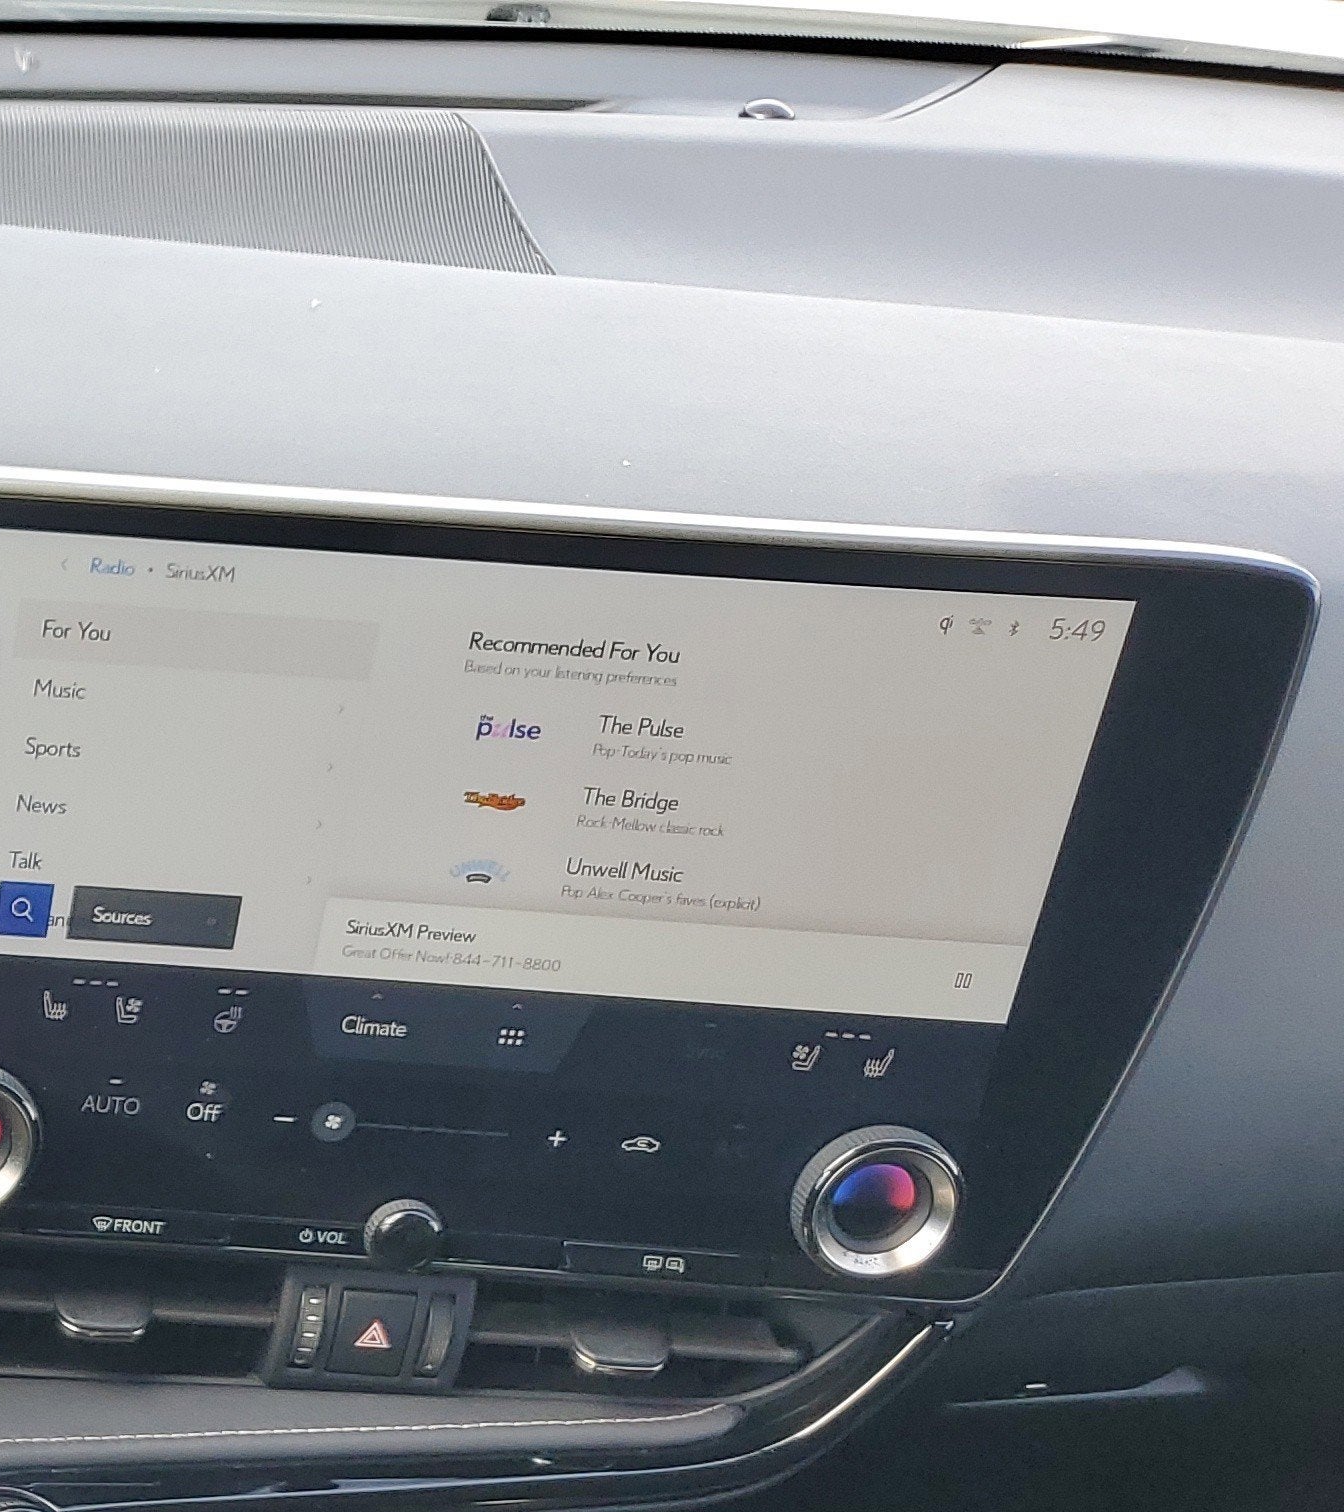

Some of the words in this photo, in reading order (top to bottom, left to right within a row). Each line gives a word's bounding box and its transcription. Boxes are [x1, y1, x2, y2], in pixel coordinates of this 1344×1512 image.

[90, 557, 135, 576] Radio
[166, 563, 235, 583] SiriusXM
[42, 619, 71, 638] For
[78, 622, 111, 641] You
[1049, 617, 1106, 642] 5:49
[469, 631, 606, 659] Recommended
[609, 641, 640, 661] For
[646, 643, 680, 663] You
[464, 660, 502, 675] Based
[505, 665, 520, 676] on
[524, 666, 550, 678] your
[555, 666, 602, 686] listening
[605, 671, 677, 687] preferences
[33, 679, 86, 699] Music
[600, 714, 633, 735] The
[637, 717, 684, 738] Pulse
[25, 737, 81, 760] Sports
[668, 751, 693, 765] pop
[696, 751, 732, 765] music
[16, 794, 67, 815] News
[584, 787, 616, 806] The
[621, 789, 679, 814] Bridge
[660, 819, 695, 835] classic
[698, 823, 724, 837] rock
[10, 850, 42, 870] Talk
[566, 857, 628, 879] Unwell
[631, 861, 685, 883] Music
[561, 885, 583, 900] Pop
[587, 886, 614, 900] Alex
[617, 888, 672, 906] Cooper's
[675, 892, 706, 907] faves
[709, 894, 761, 912] (explicit)
[92, 906, 153, 926] Sources
[345, 919, 413, 939] SiriusXM
[416, 924, 477, 943] Preview
[342, 945, 377, 960] Great
[379, 947, 413, 962] Offer
[341, 1015, 408, 1038] Climate
[81, 1094, 141, 1115] AUTO
[186, 1102, 223, 1122] Off
[113, 1218, 166, 1235] FRONT
[317, 1230, 347, 1245] VOL
